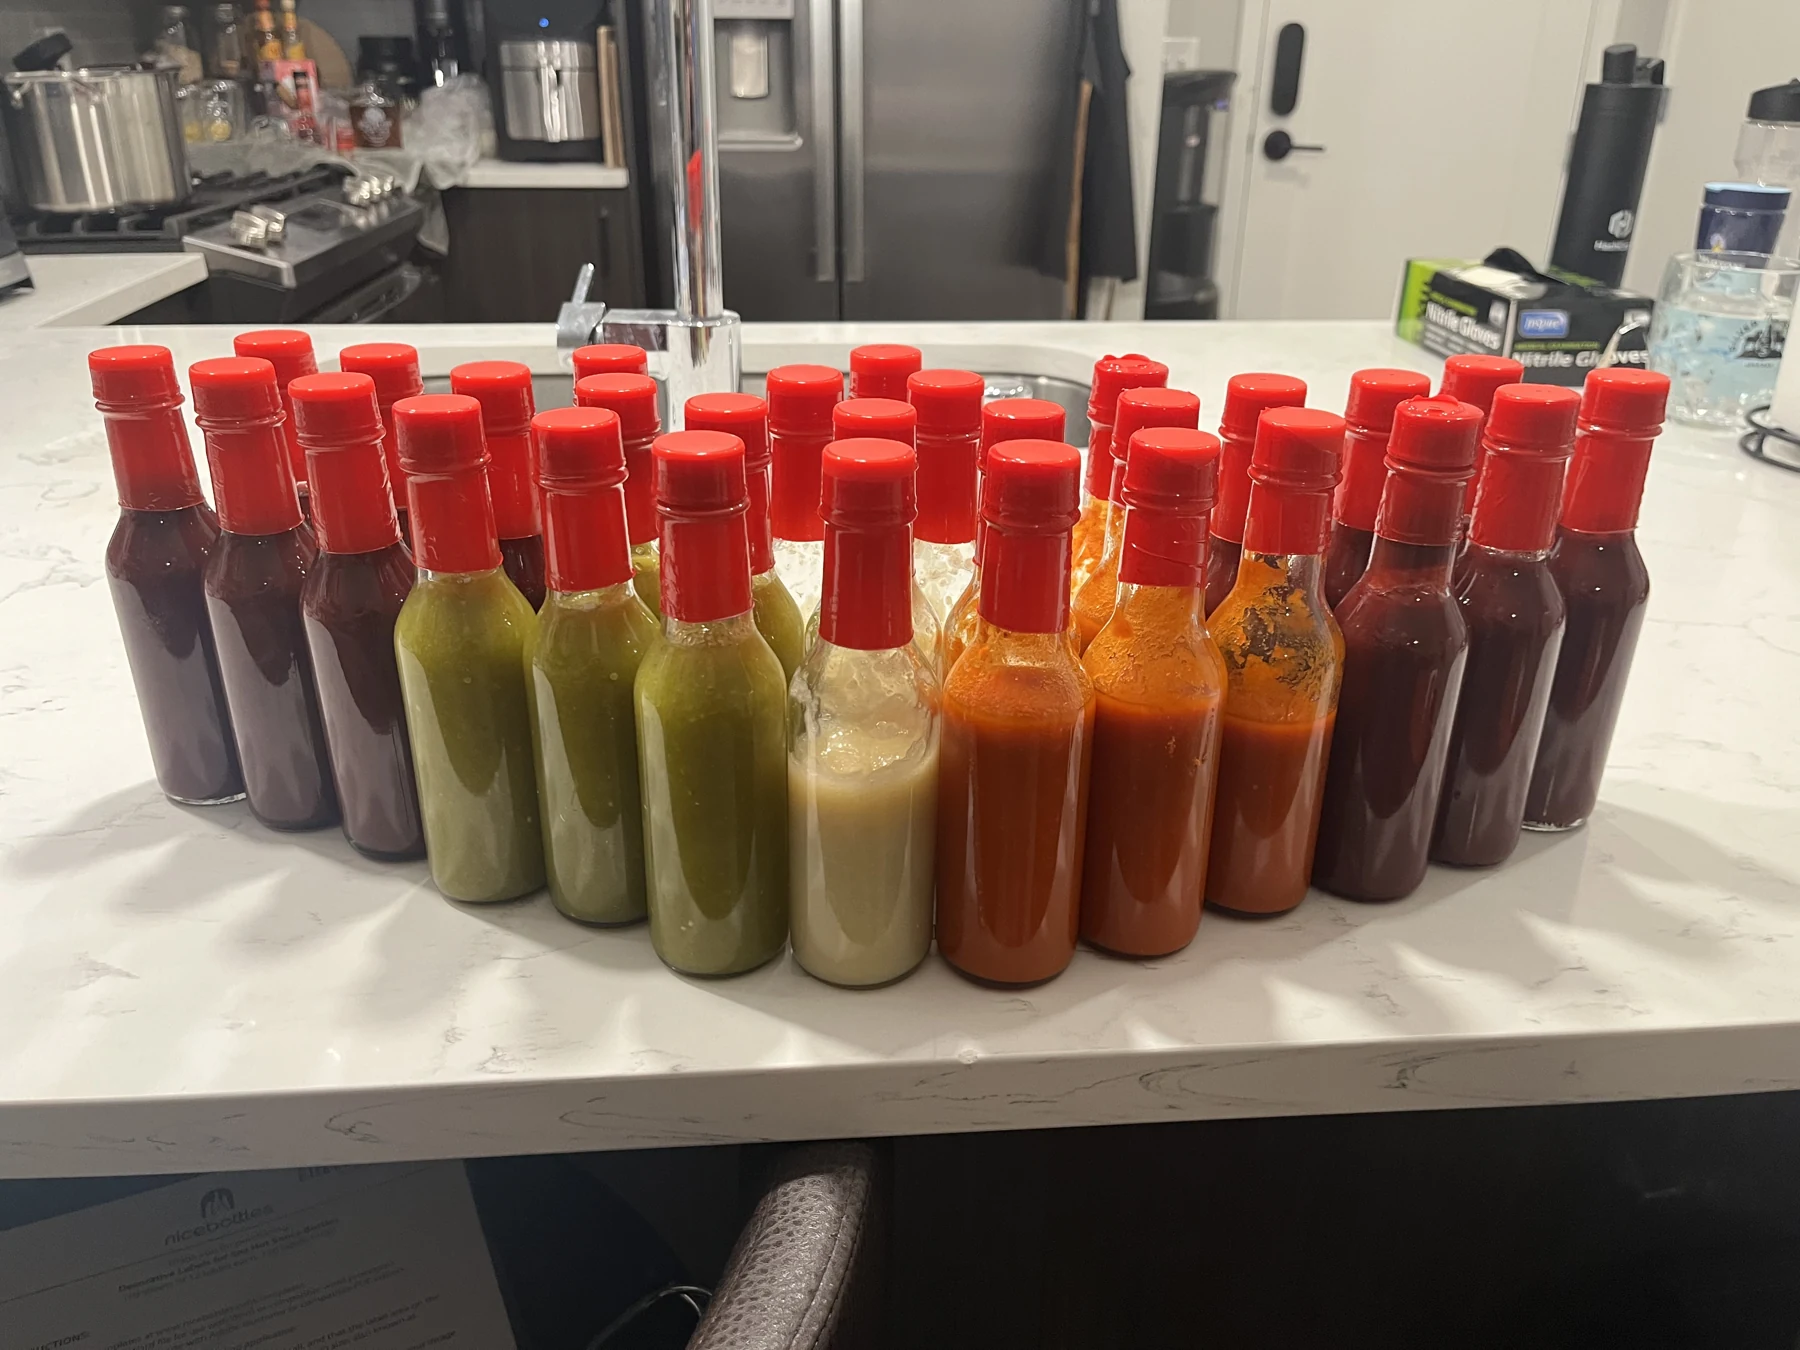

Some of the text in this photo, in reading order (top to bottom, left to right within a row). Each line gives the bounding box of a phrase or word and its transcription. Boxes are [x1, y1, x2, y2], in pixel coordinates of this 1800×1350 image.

[1425, 301, 1460, 333] Nitrile
[1459, 315, 1502, 350] Gloves
[164, 1203, 274, 1246] nicebottles
